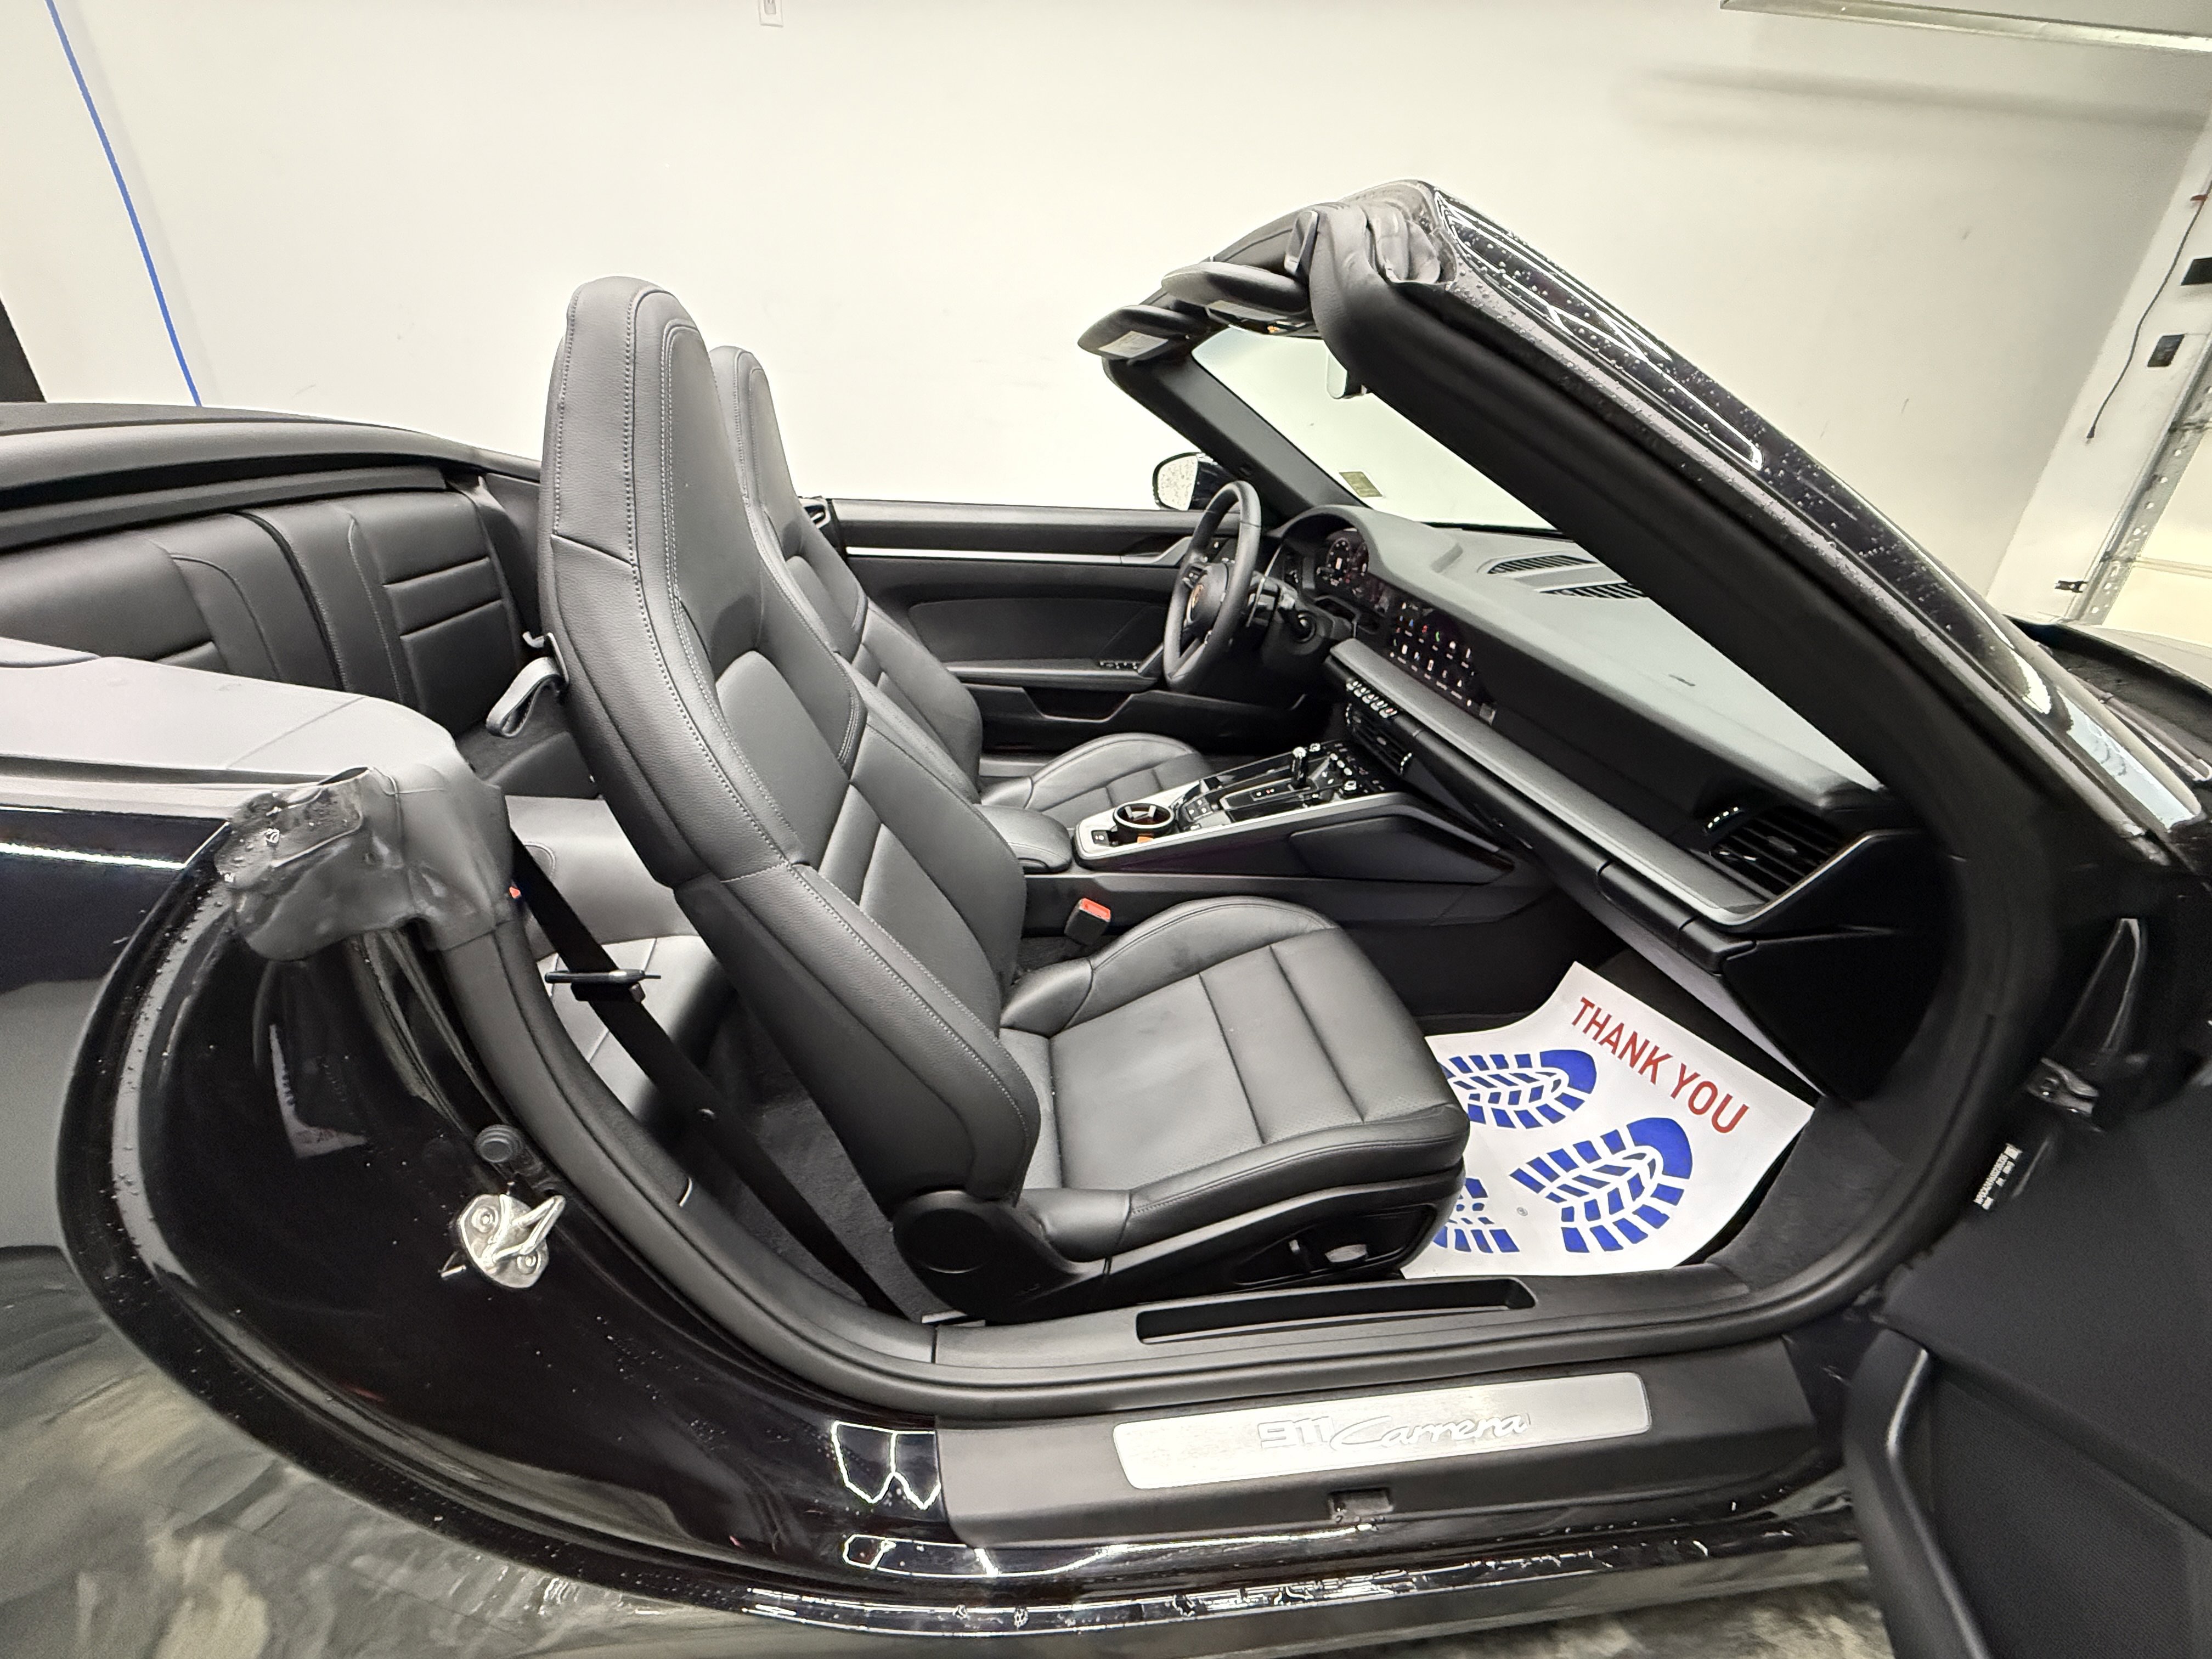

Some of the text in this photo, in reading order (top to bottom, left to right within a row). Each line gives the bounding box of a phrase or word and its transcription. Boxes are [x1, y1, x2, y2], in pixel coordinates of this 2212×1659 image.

[1571, 997, 1750, 1133] THANK YOU
[1257, 1413, 1531, 1451] 911 Carrera
